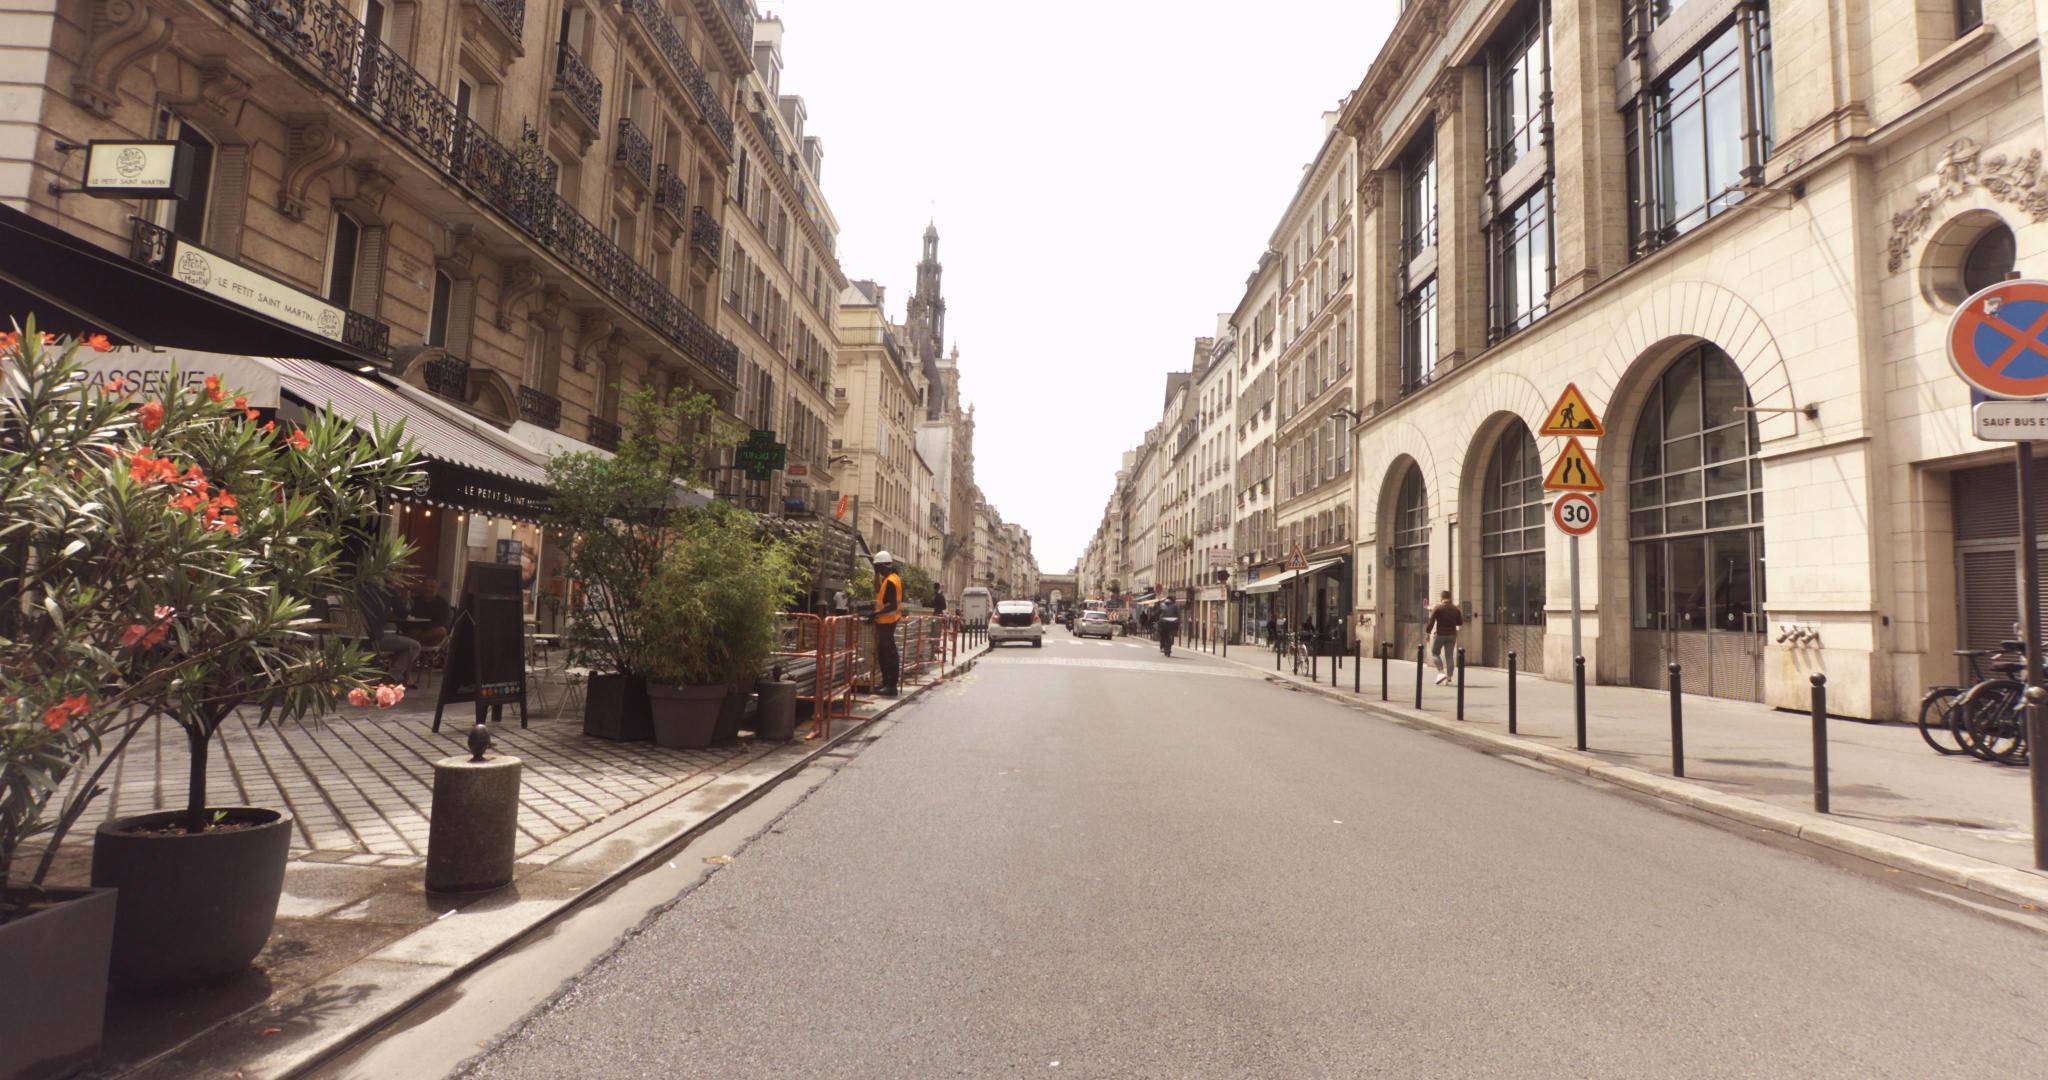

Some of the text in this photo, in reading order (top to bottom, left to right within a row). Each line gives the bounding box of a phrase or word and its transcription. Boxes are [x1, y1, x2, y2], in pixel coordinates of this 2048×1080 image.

[232, 282, 254, 298] PETIT
[258, 293, 280, 308] SAINT
[1983, 418, 2011, 426] SAUF
[2015, 418, 2036, 426] BUS
[464, 485, 474, 496] LE
[477, 487, 501, 501] PETIT
[504, 494, 526, 506] SAINT
[1563, 504, 1590, 523] 30
